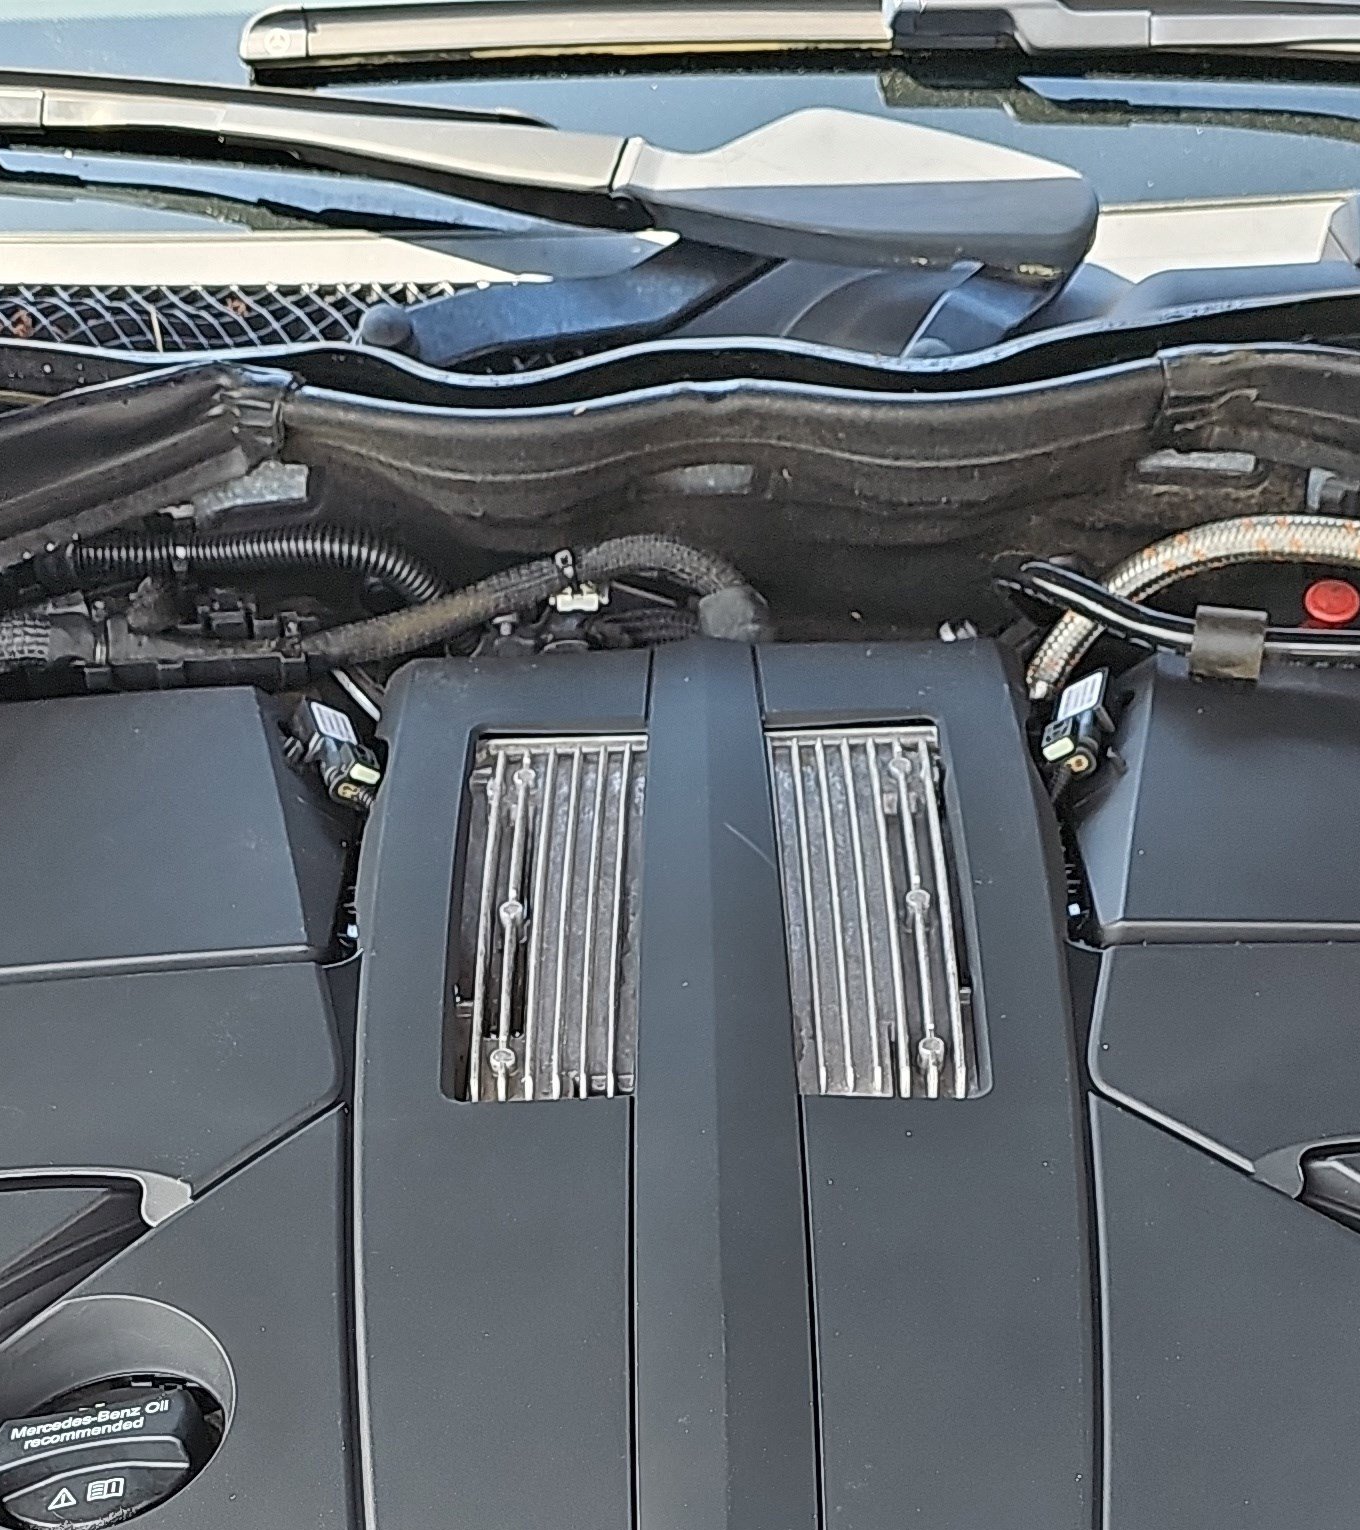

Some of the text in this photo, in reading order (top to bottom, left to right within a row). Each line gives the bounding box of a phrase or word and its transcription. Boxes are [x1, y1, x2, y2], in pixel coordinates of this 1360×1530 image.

[10, 1399, 170, 1440] Mercedes-Benz Oil
[23, 1416, 145, 1450] recommended
